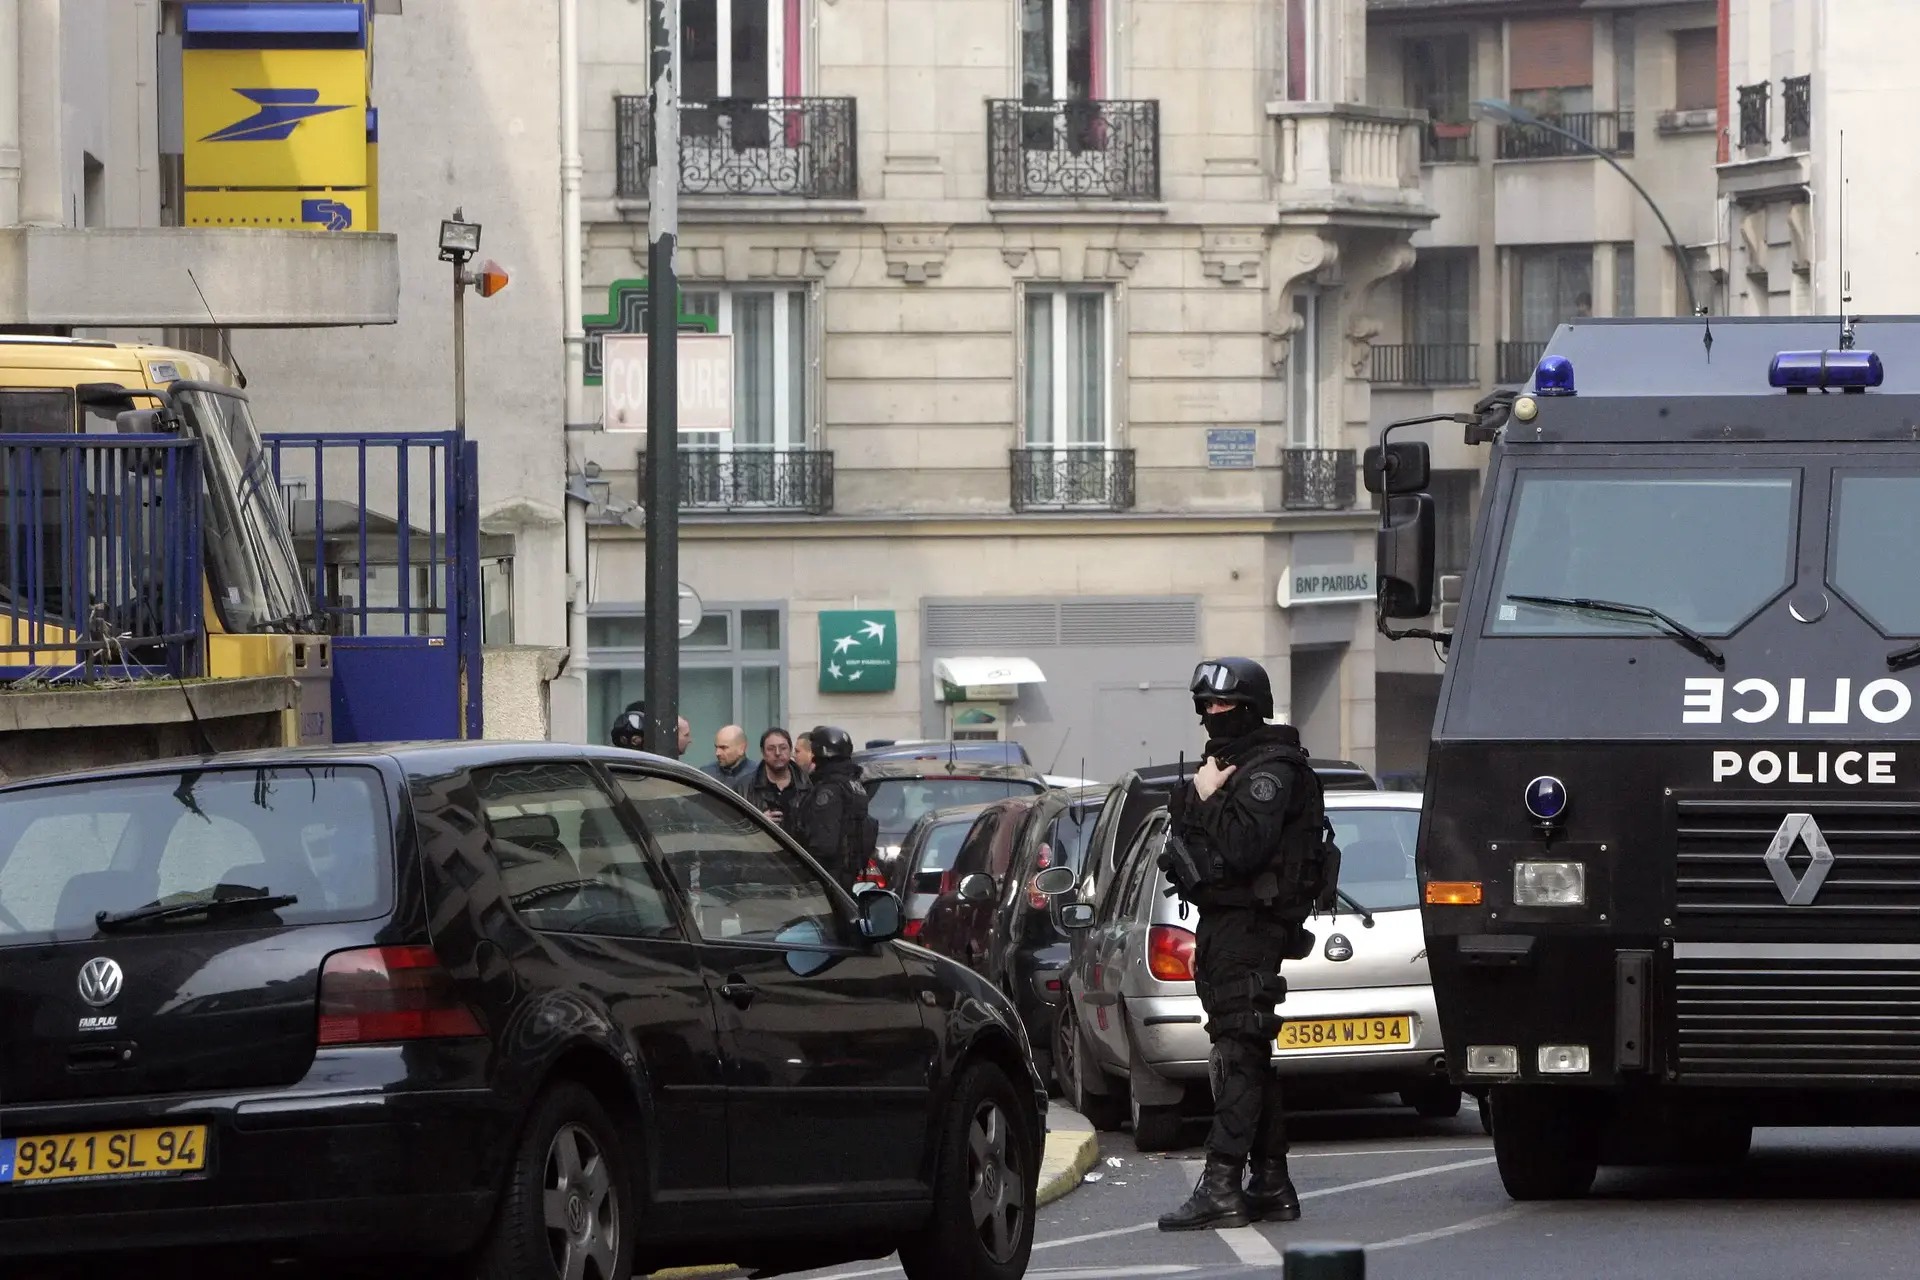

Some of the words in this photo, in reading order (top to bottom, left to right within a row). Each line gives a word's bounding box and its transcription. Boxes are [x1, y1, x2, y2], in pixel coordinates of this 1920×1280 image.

[608, 358, 730, 409] COURE
[1296, 576, 1319, 593] BNP
[1322, 574, 1368, 592] PARIBAS
[1713, 750, 1896, 784] POLICE
[1286, 1023, 1337, 1044] 3584
[1343, 1022, 1368, 1041] WJ
[1374, 1020, 1401, 1039] 94
[1, 1164, 9, 1175] F
[18, 1136, 96, 1176] 9341
[107, 1134, 147, 1168] SL
[156, 1130, 197, 1165] 94
